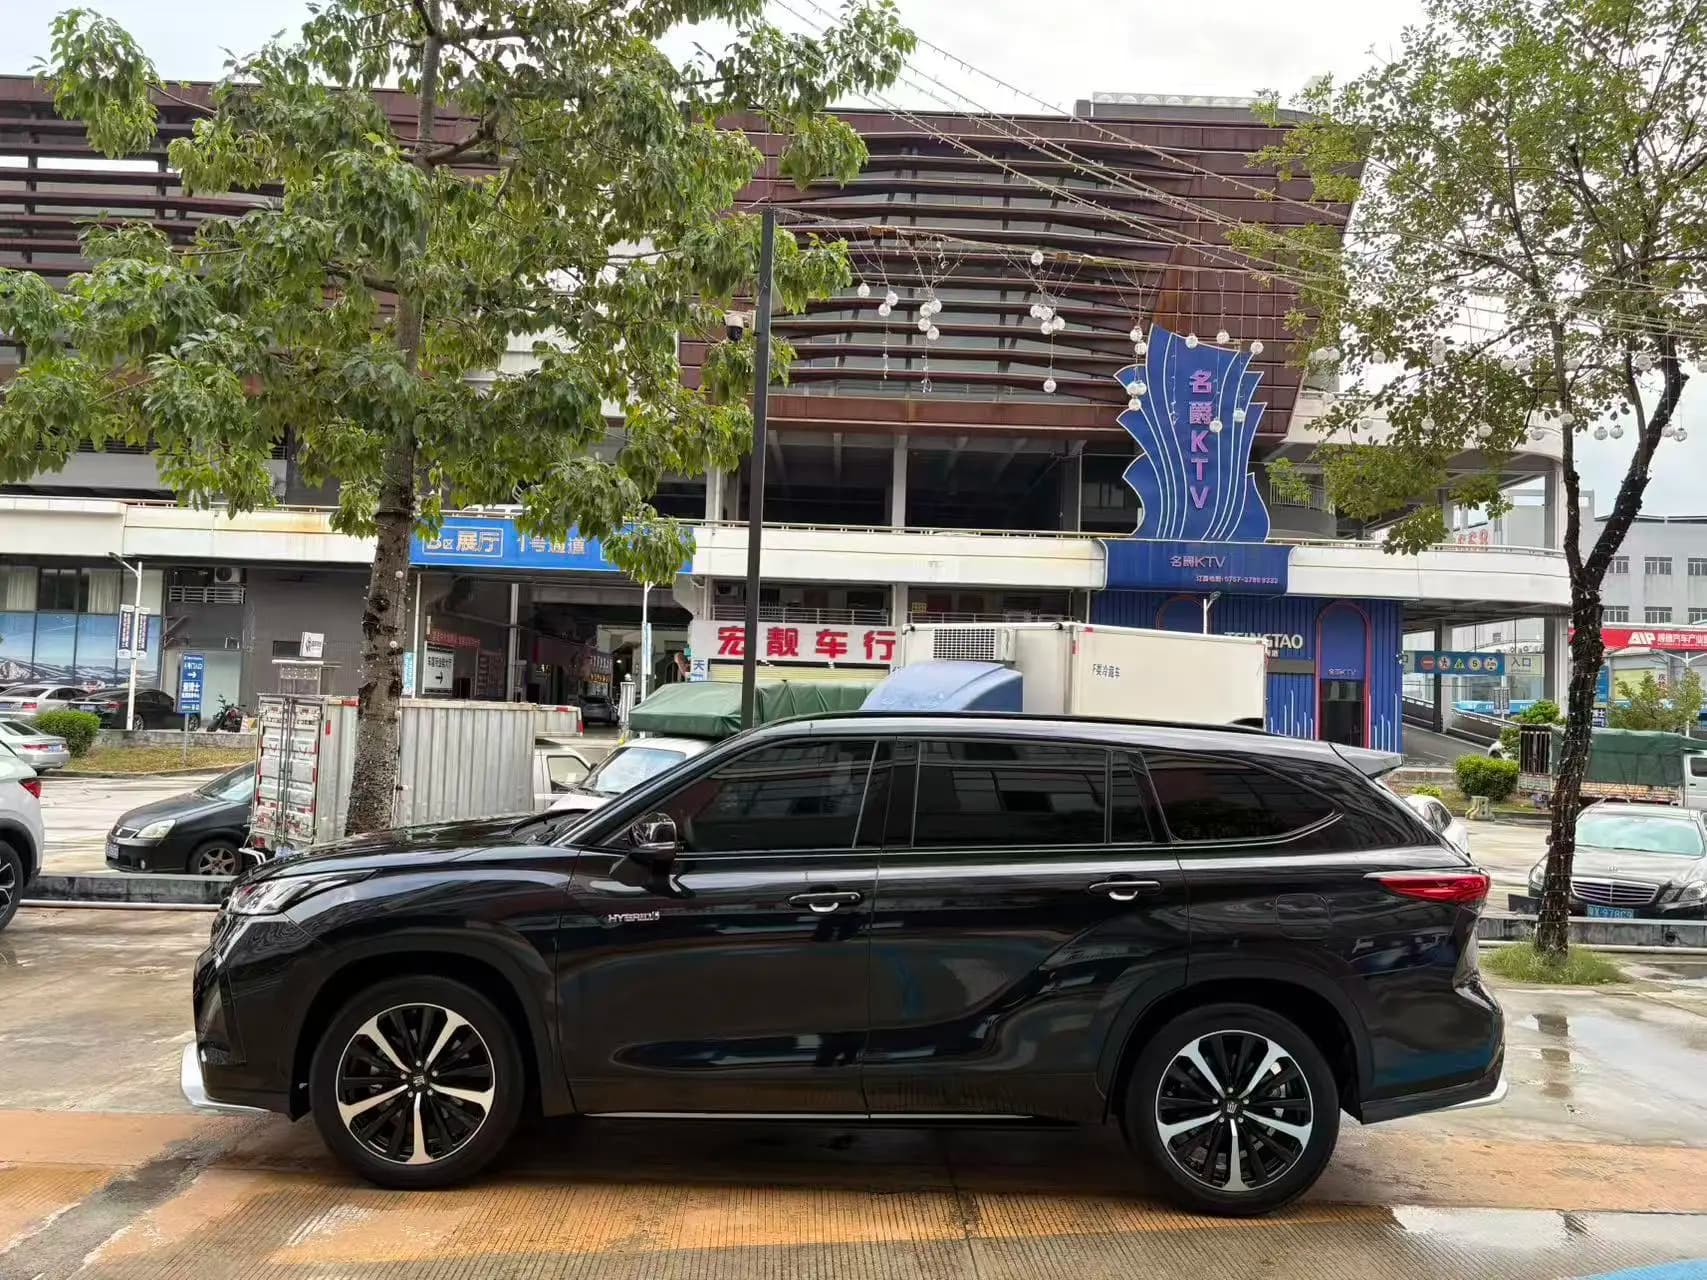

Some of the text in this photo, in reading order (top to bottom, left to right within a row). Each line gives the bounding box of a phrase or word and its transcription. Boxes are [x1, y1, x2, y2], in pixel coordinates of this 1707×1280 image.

[1189, 369, 1214, 509] 名爵KTV
[1170, 555, 1226, 569] 名爵KTV
[717, 625, 896, 661] 宏靓车行
[1510, 657, 1532, 667] 入口
[608, 912, 654, 923] HYBRID
